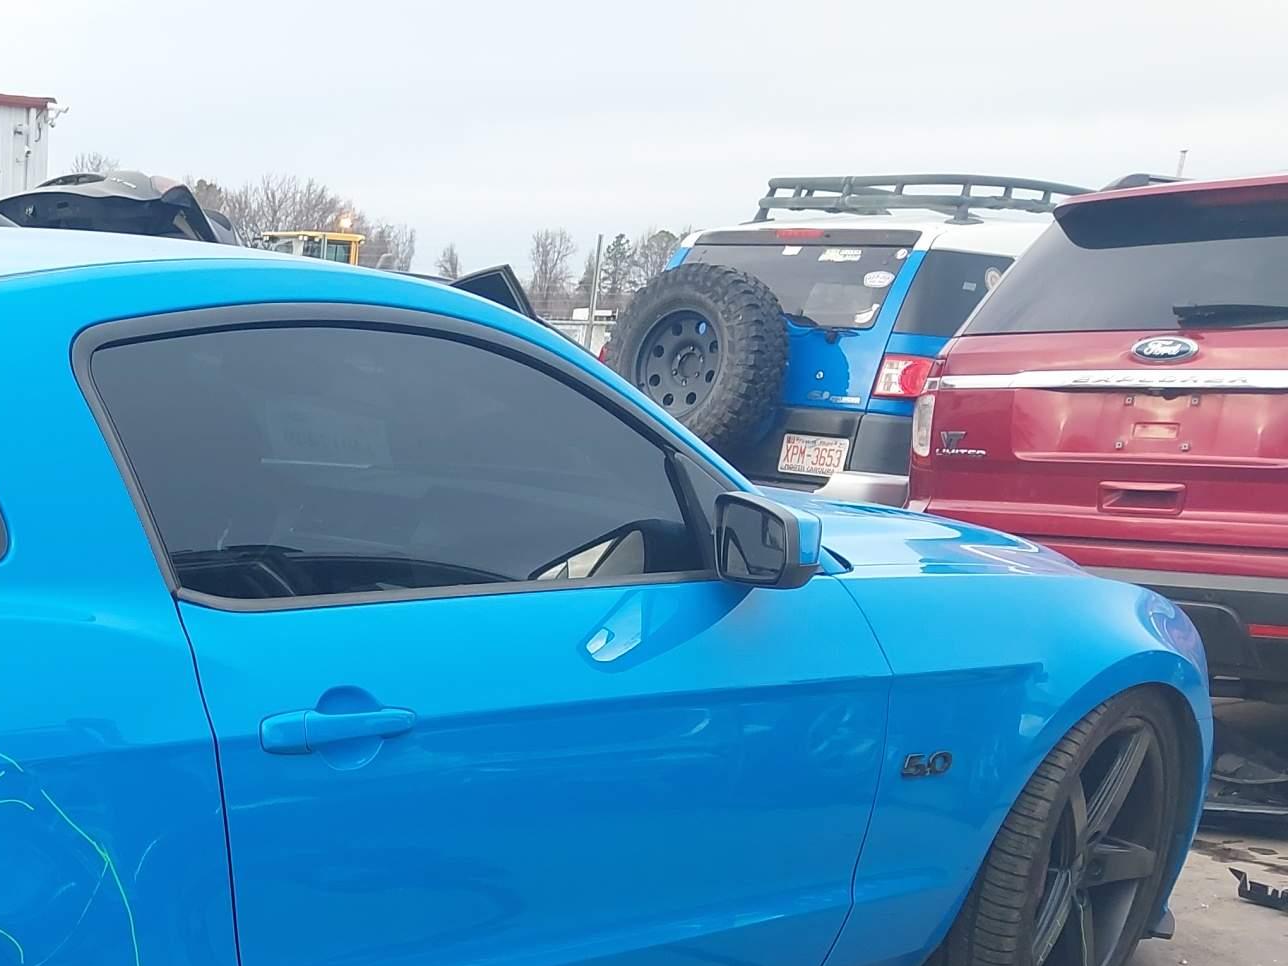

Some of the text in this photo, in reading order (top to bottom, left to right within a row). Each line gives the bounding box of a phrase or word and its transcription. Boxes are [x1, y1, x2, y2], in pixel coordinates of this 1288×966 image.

[1143, 340, 1182, 356] Ford
[1071, 374, 1249, 384] EXPLORER
[783, 444, 843, 468] XPM-3653
[903, 751, 953, 776] 5.0
